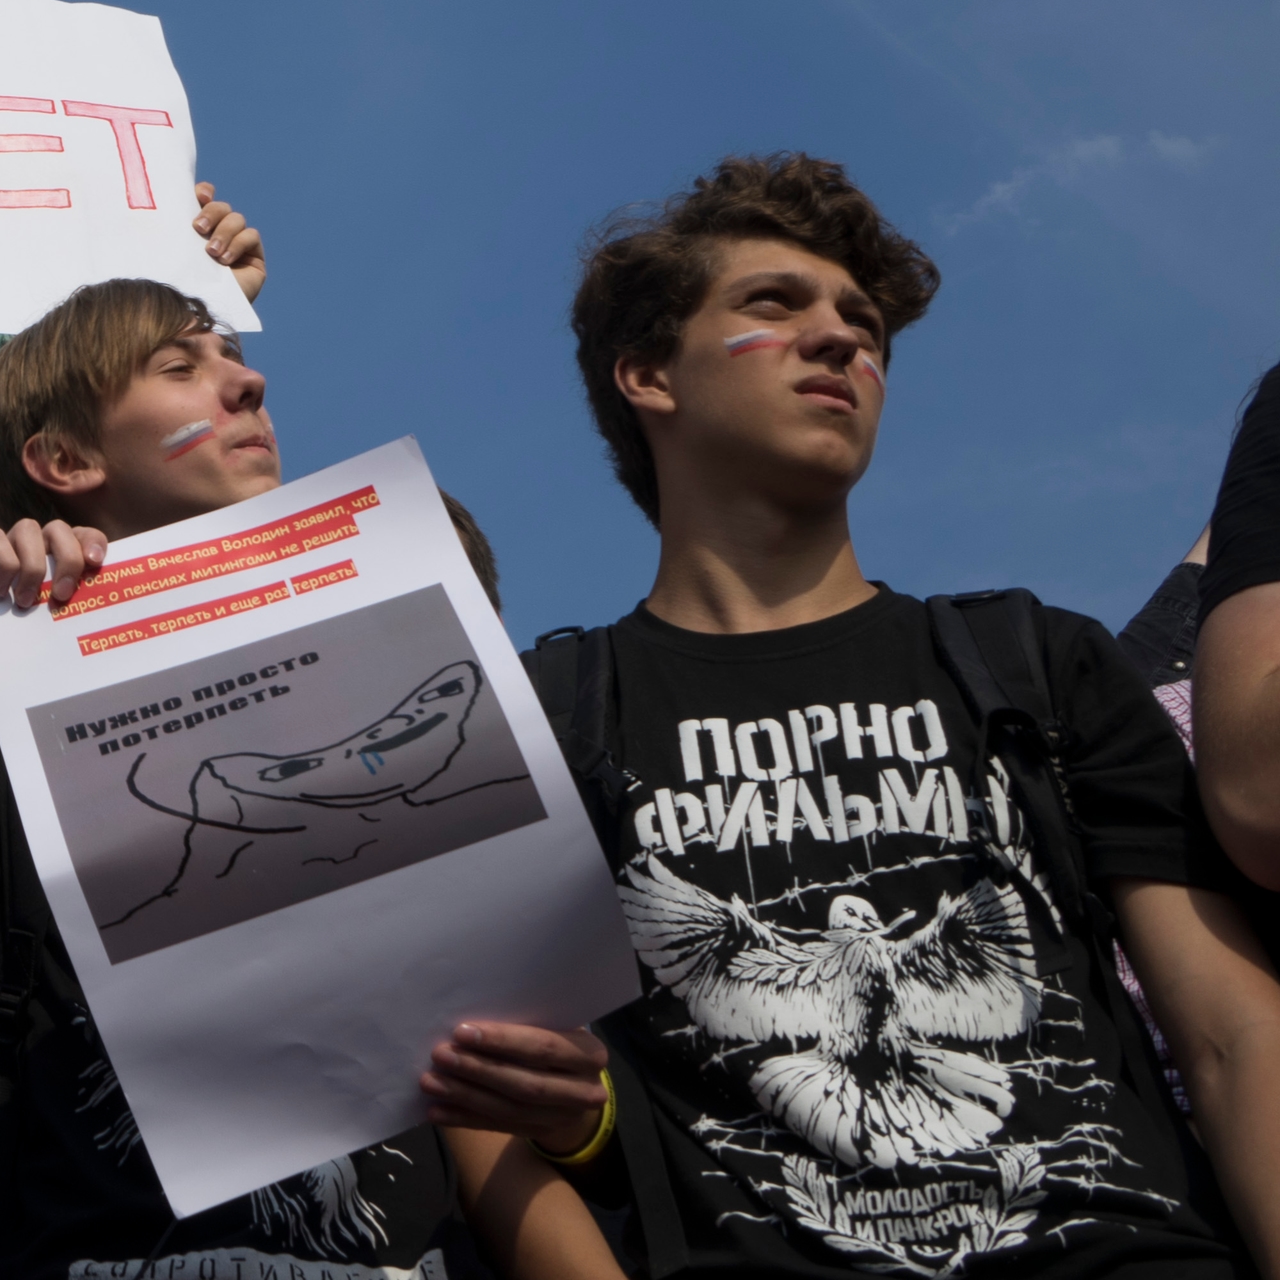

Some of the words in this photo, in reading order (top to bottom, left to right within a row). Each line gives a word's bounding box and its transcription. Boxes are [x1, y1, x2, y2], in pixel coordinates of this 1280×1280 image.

[51, 594, 106, 619] вопрос
[108, 591, 119, 602] о
[123, 572, 187, 598] пенсиях
[191, 549, 278, 580] митингами
[279, 543, 300, 557] не
[302, 524, 359, 552] решить
[147, 546, 219, 571] Вячеслав
[221, 525, 290, 552] Володин
[293, 505, 351, 532] заявил,
[351, 492, 379, 510] что
[78, 628, 149, 653] Терпеть,
[151, 609, 212, 634] терпеть
[214, 605, 227, 617] и
[230, 595, 262, 612] еще
[264, 585, 290, 605] раз
[292, 561, 358, 593] терпеть!
[65, 696, 182, 743] Нужно
[192, 651, 320, 703] просто
[98, 683, 291, 756] потерпеть
[677, 698, 949, 782] ПОРНО
[844, 1180, 984, 1216] МОЛОДОСТЬ
